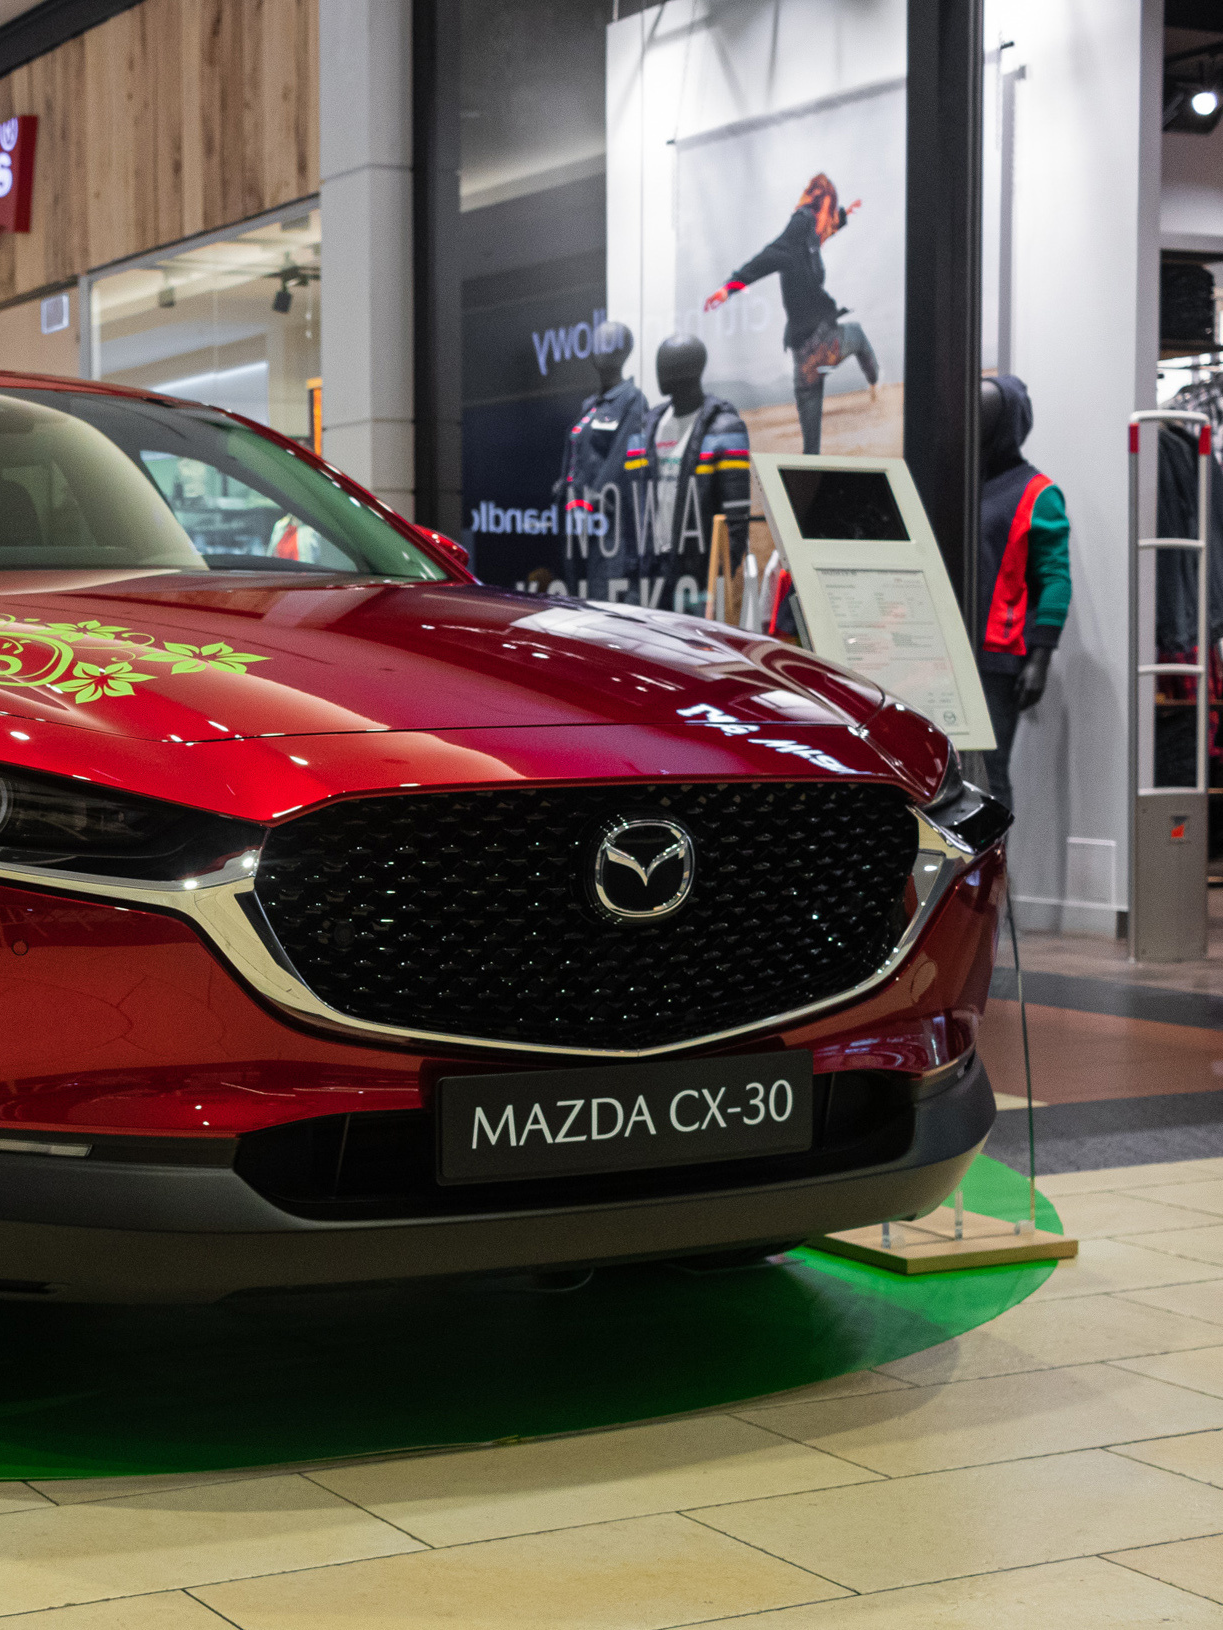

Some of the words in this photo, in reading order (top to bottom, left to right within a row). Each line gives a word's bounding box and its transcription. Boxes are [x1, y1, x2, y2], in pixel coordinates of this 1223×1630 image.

[566, 475, 706, 560] NOWA
[471, 1094, 657, 1150] MAZDA
[669, 1079, 794, 1133] CX-30
